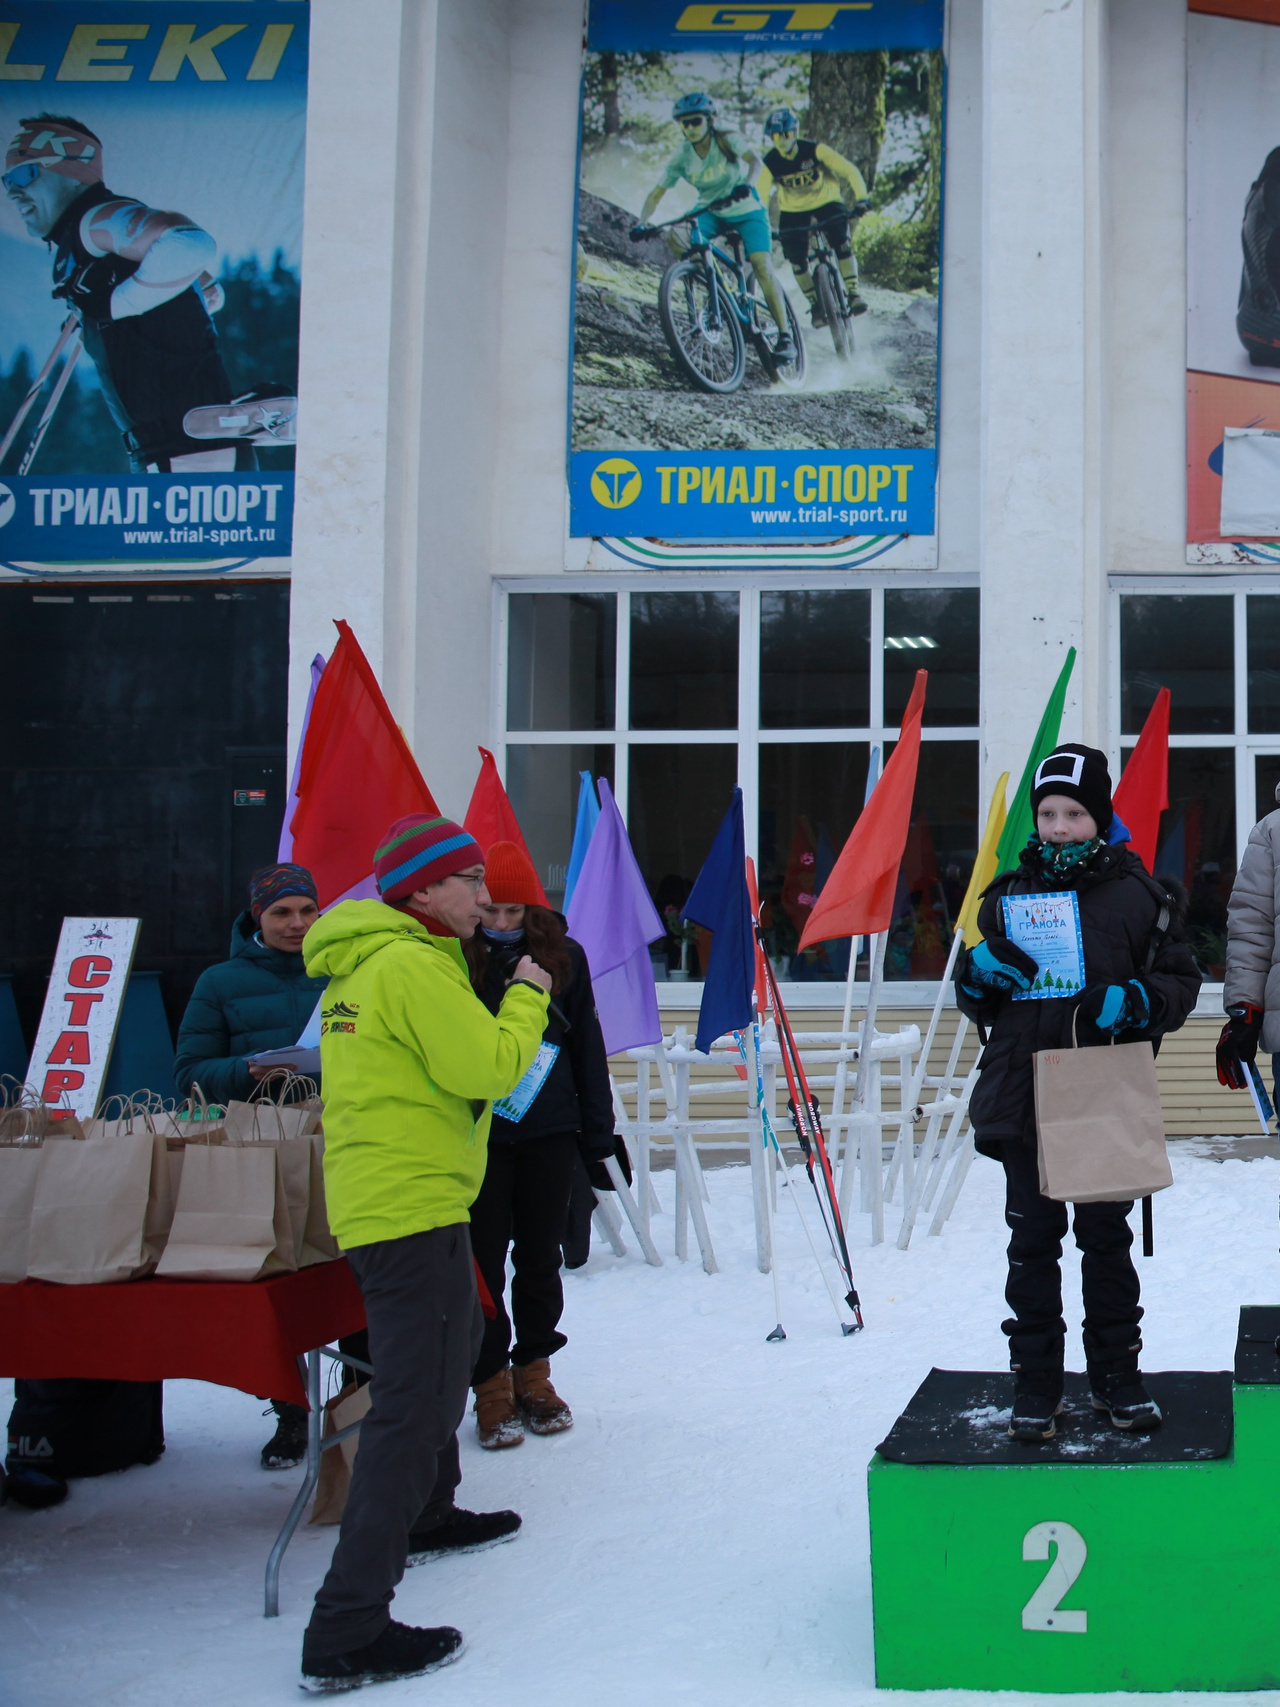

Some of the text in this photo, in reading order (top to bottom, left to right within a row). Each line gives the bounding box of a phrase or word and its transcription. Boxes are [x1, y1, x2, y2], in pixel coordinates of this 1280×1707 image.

[675, 3, 873, 31] GT
[743, 32, 824, 42] BICYCLES
[0, 23, 294, 81] LEKI
[751, 507, 908, 526] www.trial-sport.ru
[123, 527, 276, 546] www.trial-sport.ru
[1018, 919, 1067, 931] ГРАМОТА
[795, 1103, 809, 1136] NORDWAY
[1021, 1521, 1087, 1633] 2
